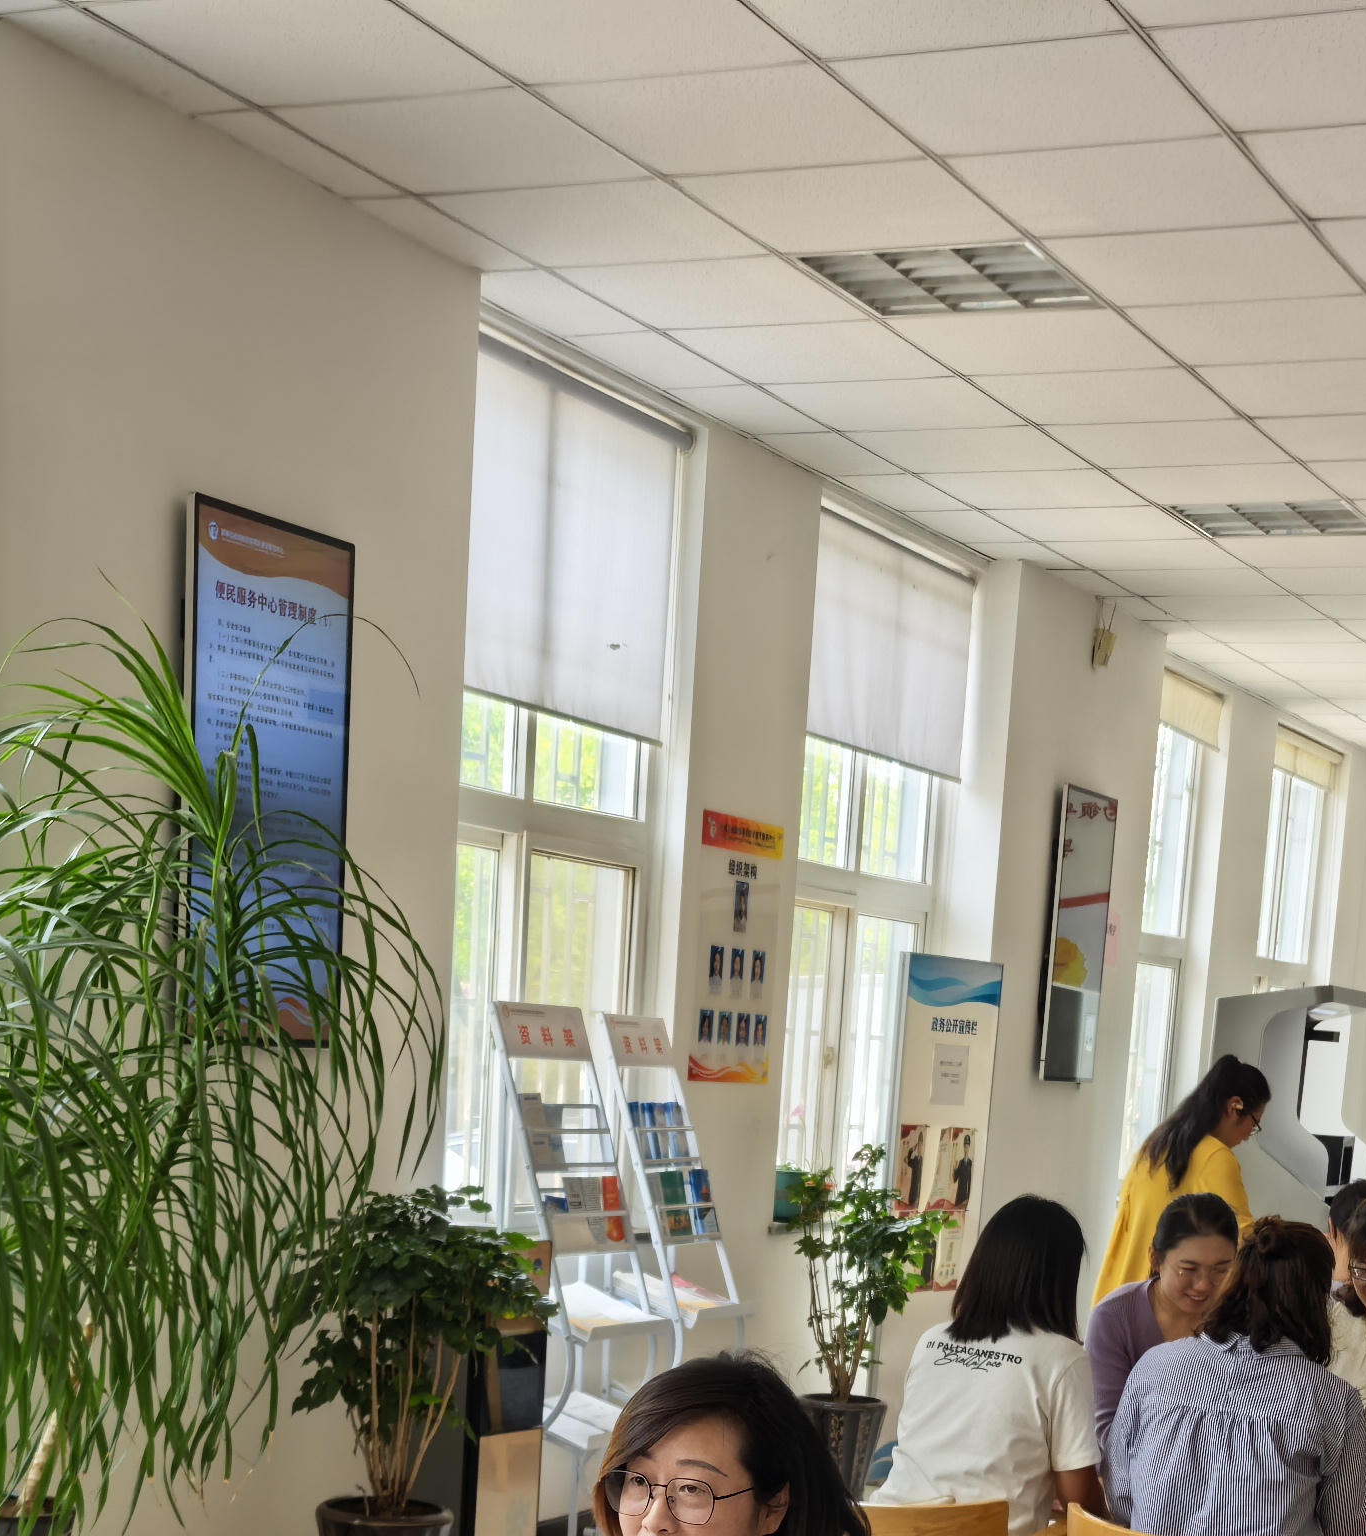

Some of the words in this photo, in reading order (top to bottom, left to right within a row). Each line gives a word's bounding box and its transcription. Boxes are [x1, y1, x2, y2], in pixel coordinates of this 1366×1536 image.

[728, 858, 757, 880] 组织架构
[518, 1024, 576, 1048] 资料架
[931, 1017, 978, 1036] 政务公开宣传栏
[622, 1035, 664, 1055] 资料架
